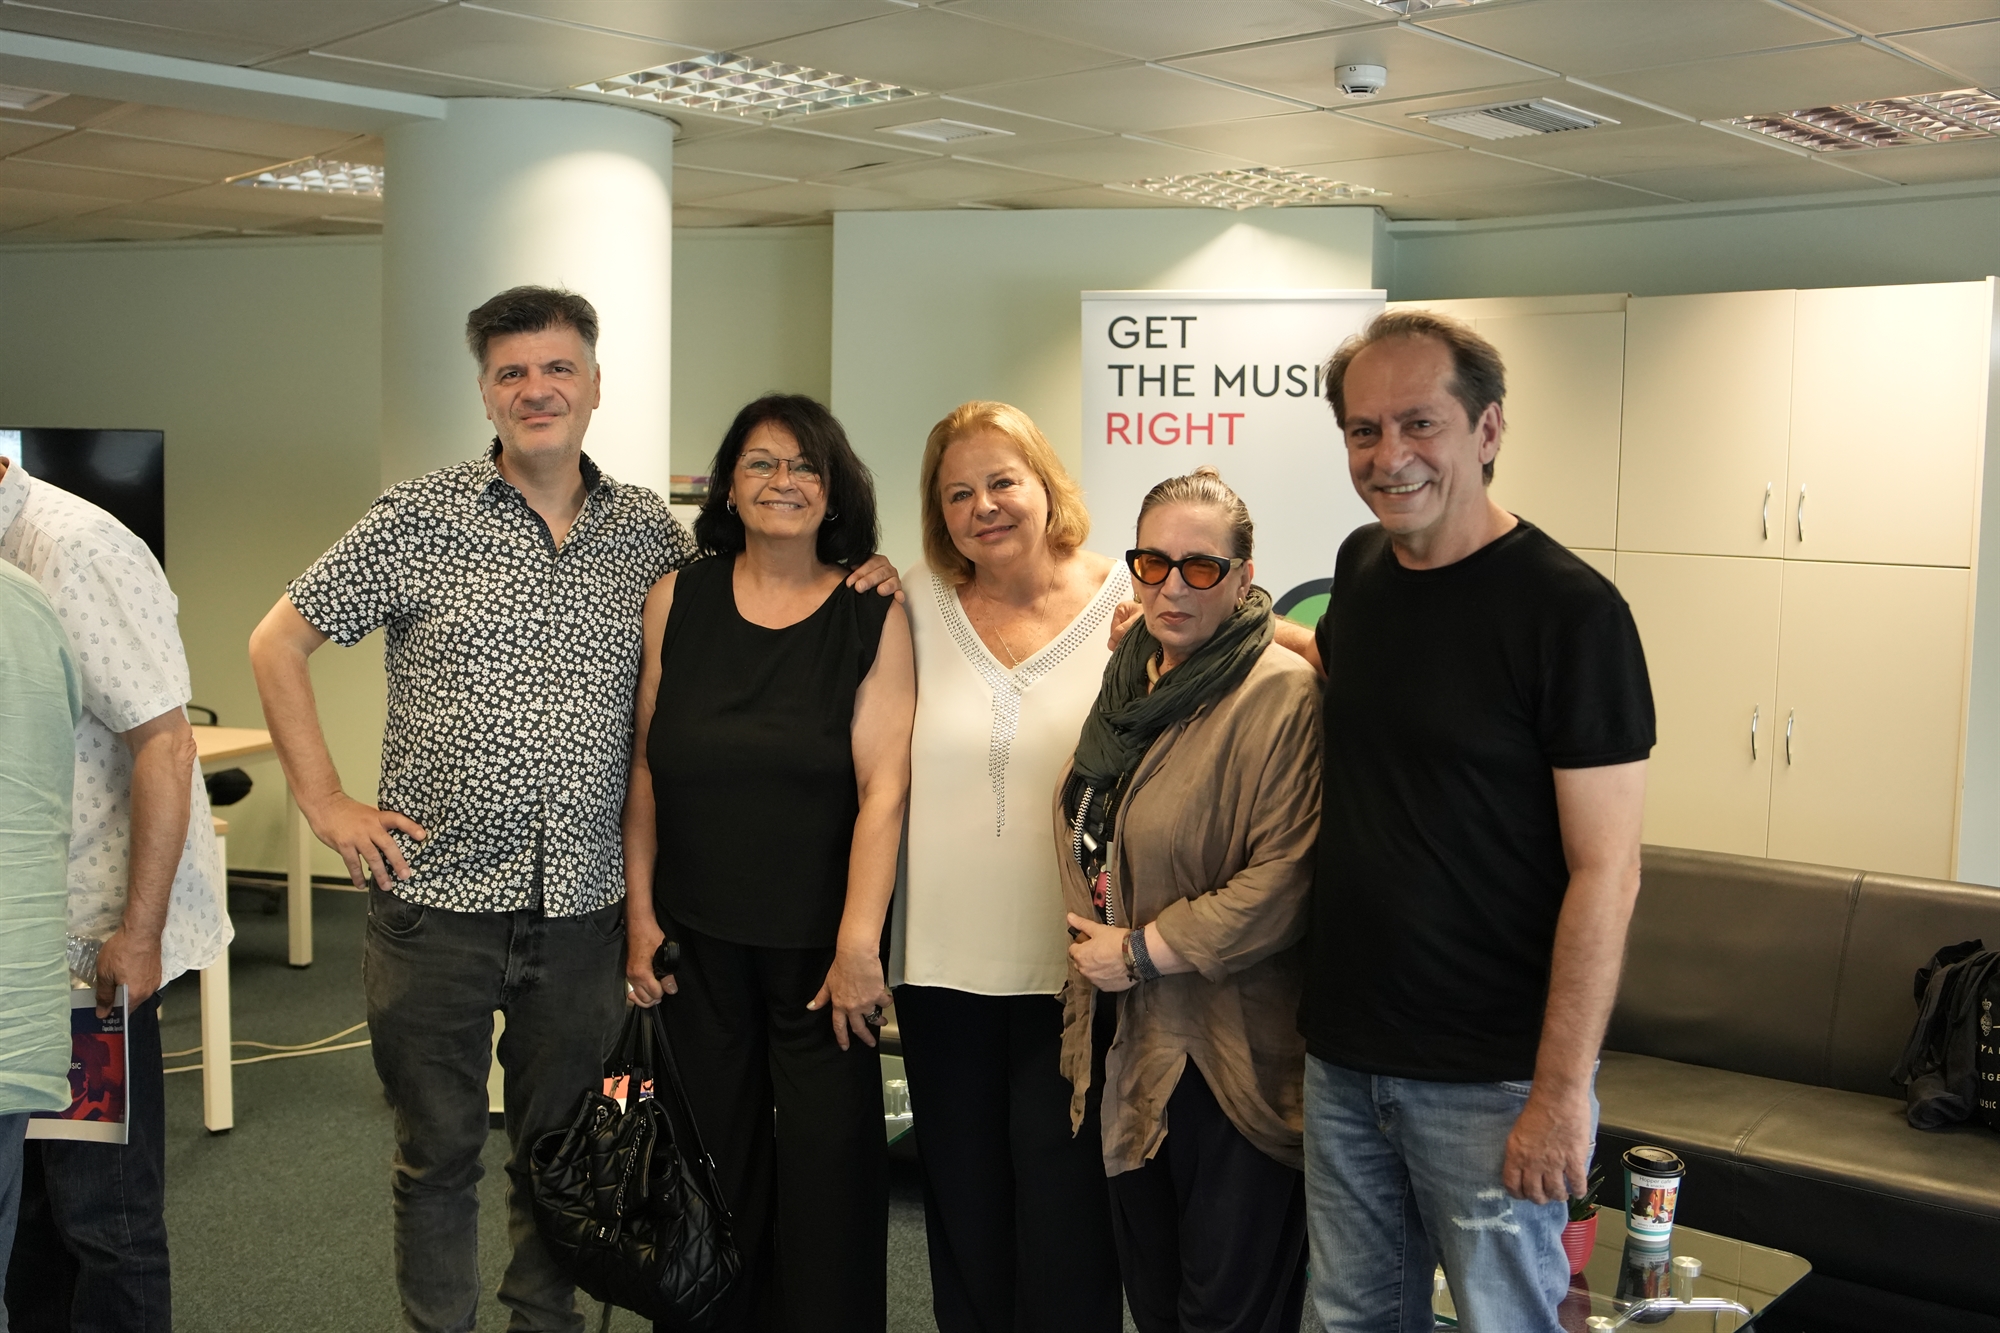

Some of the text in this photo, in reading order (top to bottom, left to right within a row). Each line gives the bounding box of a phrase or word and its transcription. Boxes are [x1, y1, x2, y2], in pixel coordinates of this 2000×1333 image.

[1107, 316, 1198, 349] GET
[1107, 364, 1320, 397] THE MUSI
[1106, 412, 1245, 445] RIGHT
[71, 1062, 82, 1070] SIC
